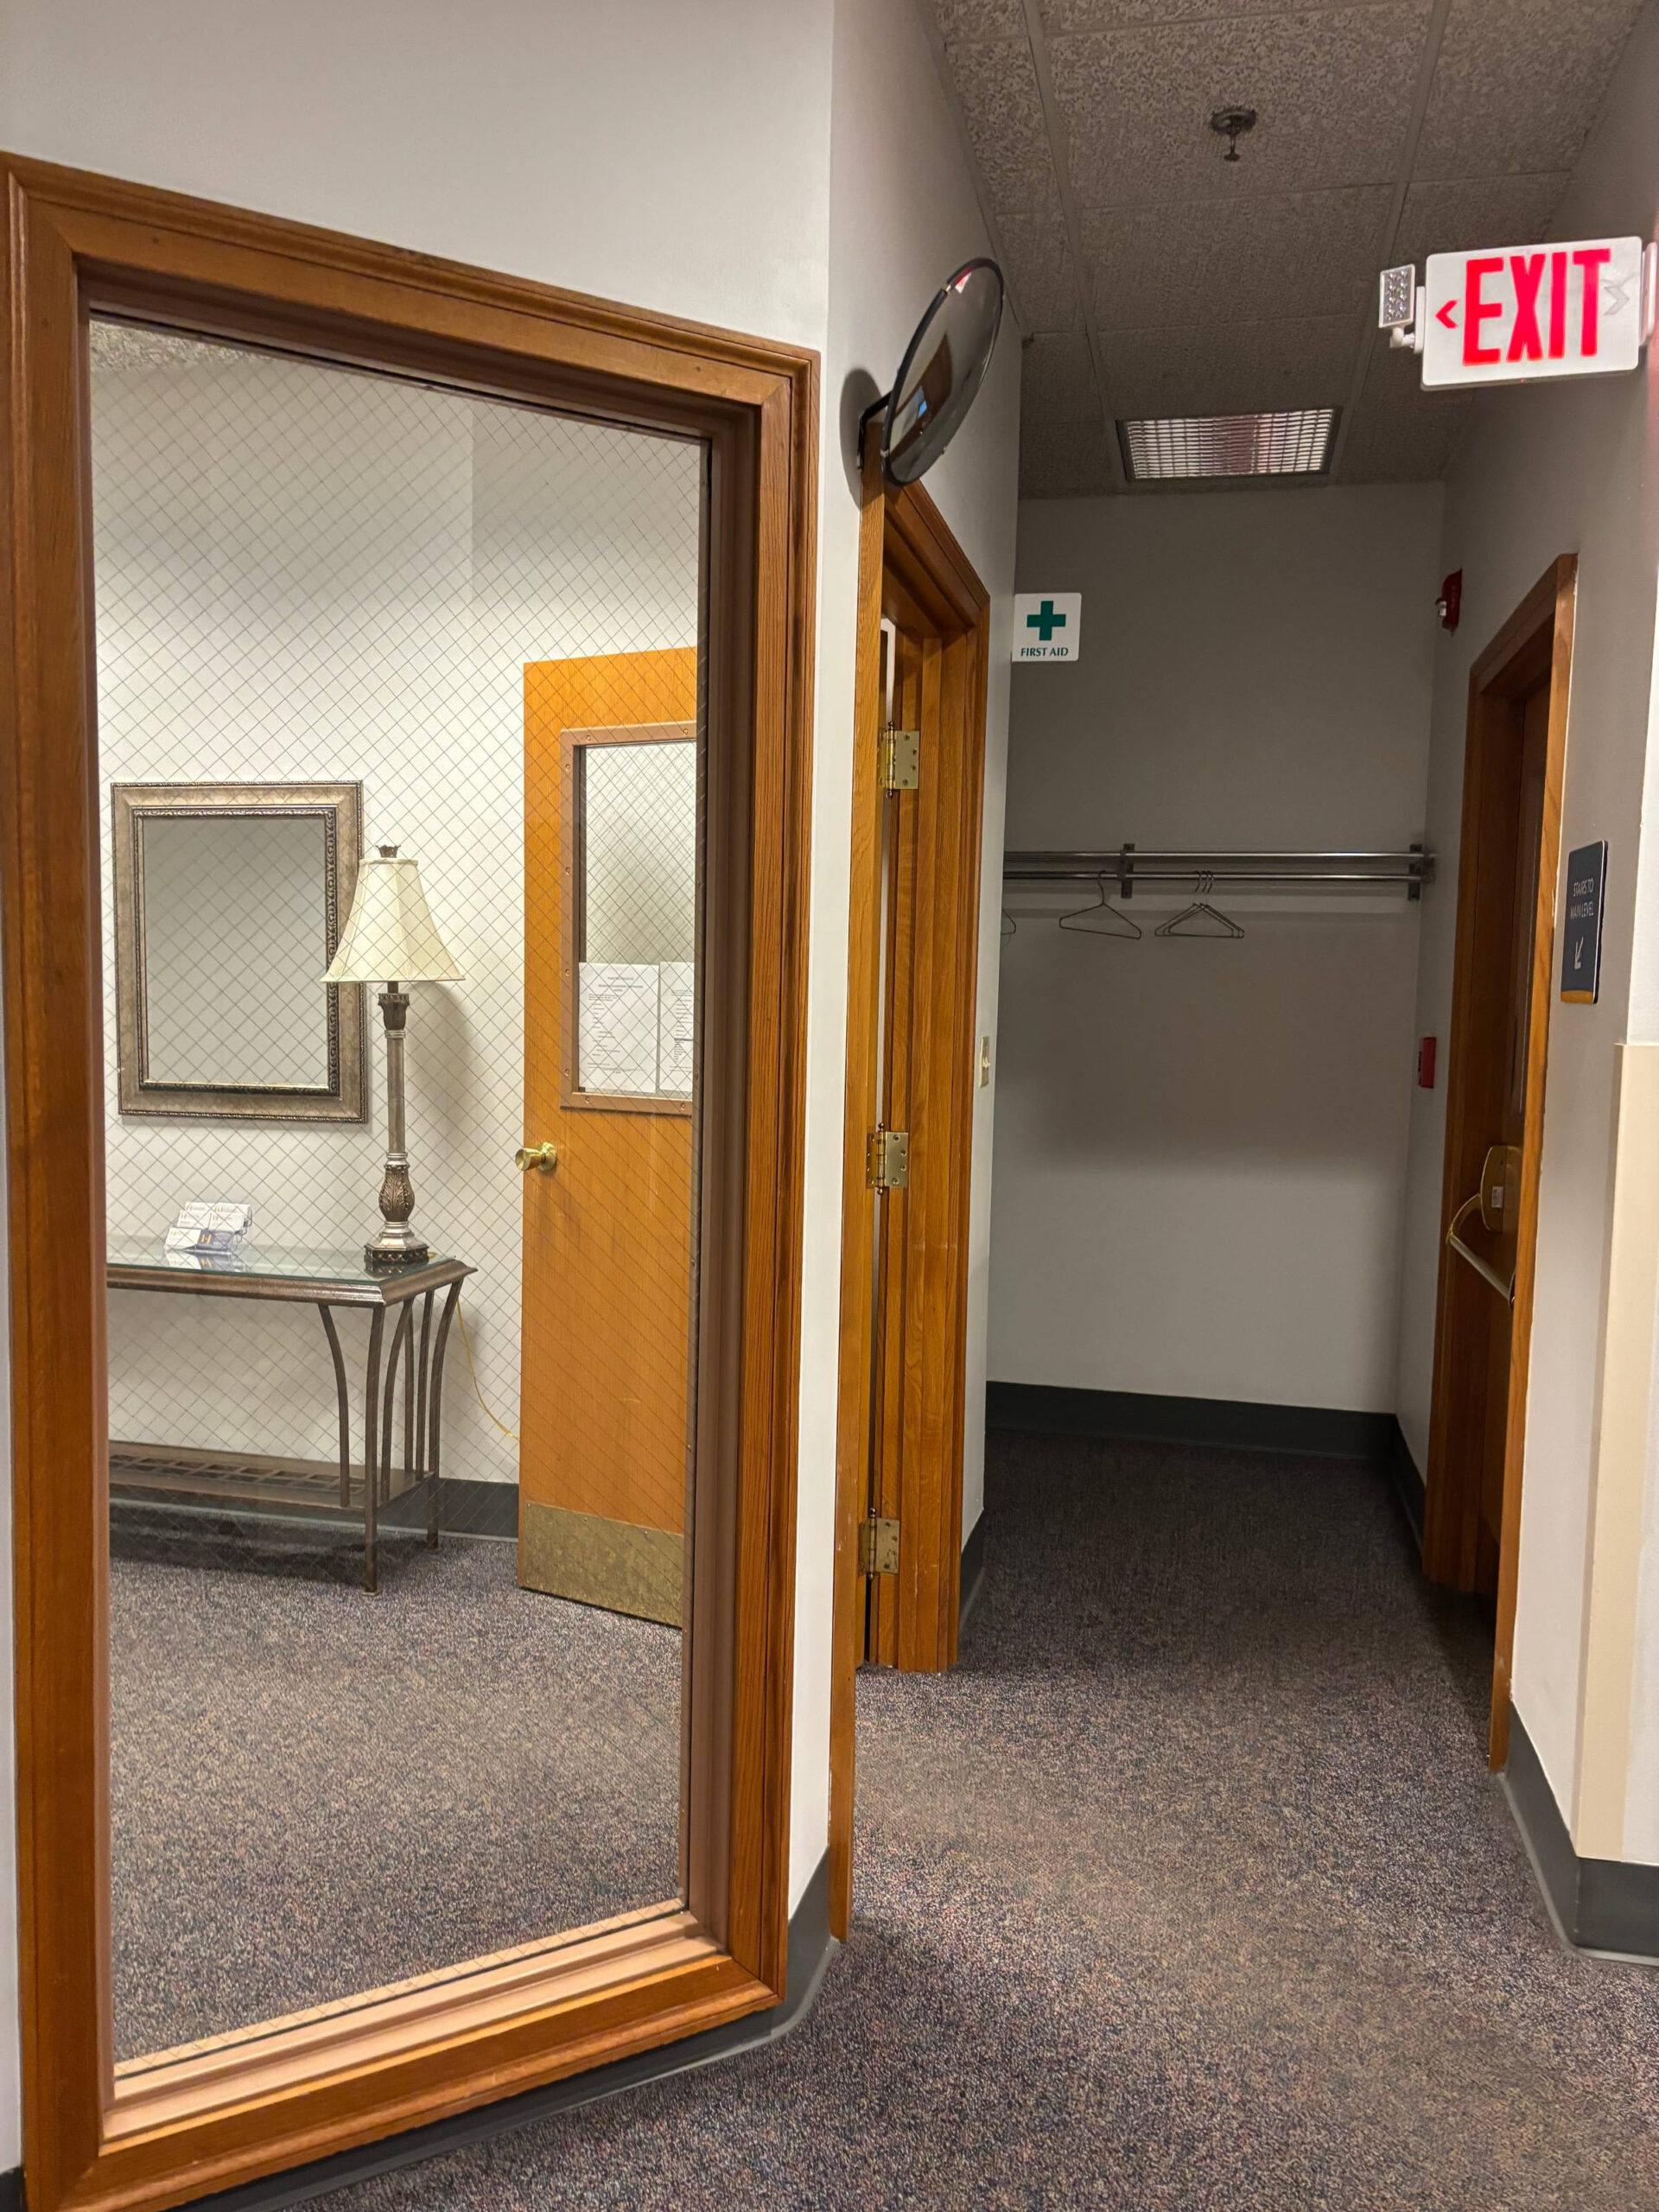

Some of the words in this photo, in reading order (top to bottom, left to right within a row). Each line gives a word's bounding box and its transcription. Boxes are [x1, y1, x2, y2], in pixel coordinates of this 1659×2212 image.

[1462, 248, 1611, 366] EXIT
[1020, 647, 1048, 657] FIRST
[1050, 647, 1069, 657] AID
